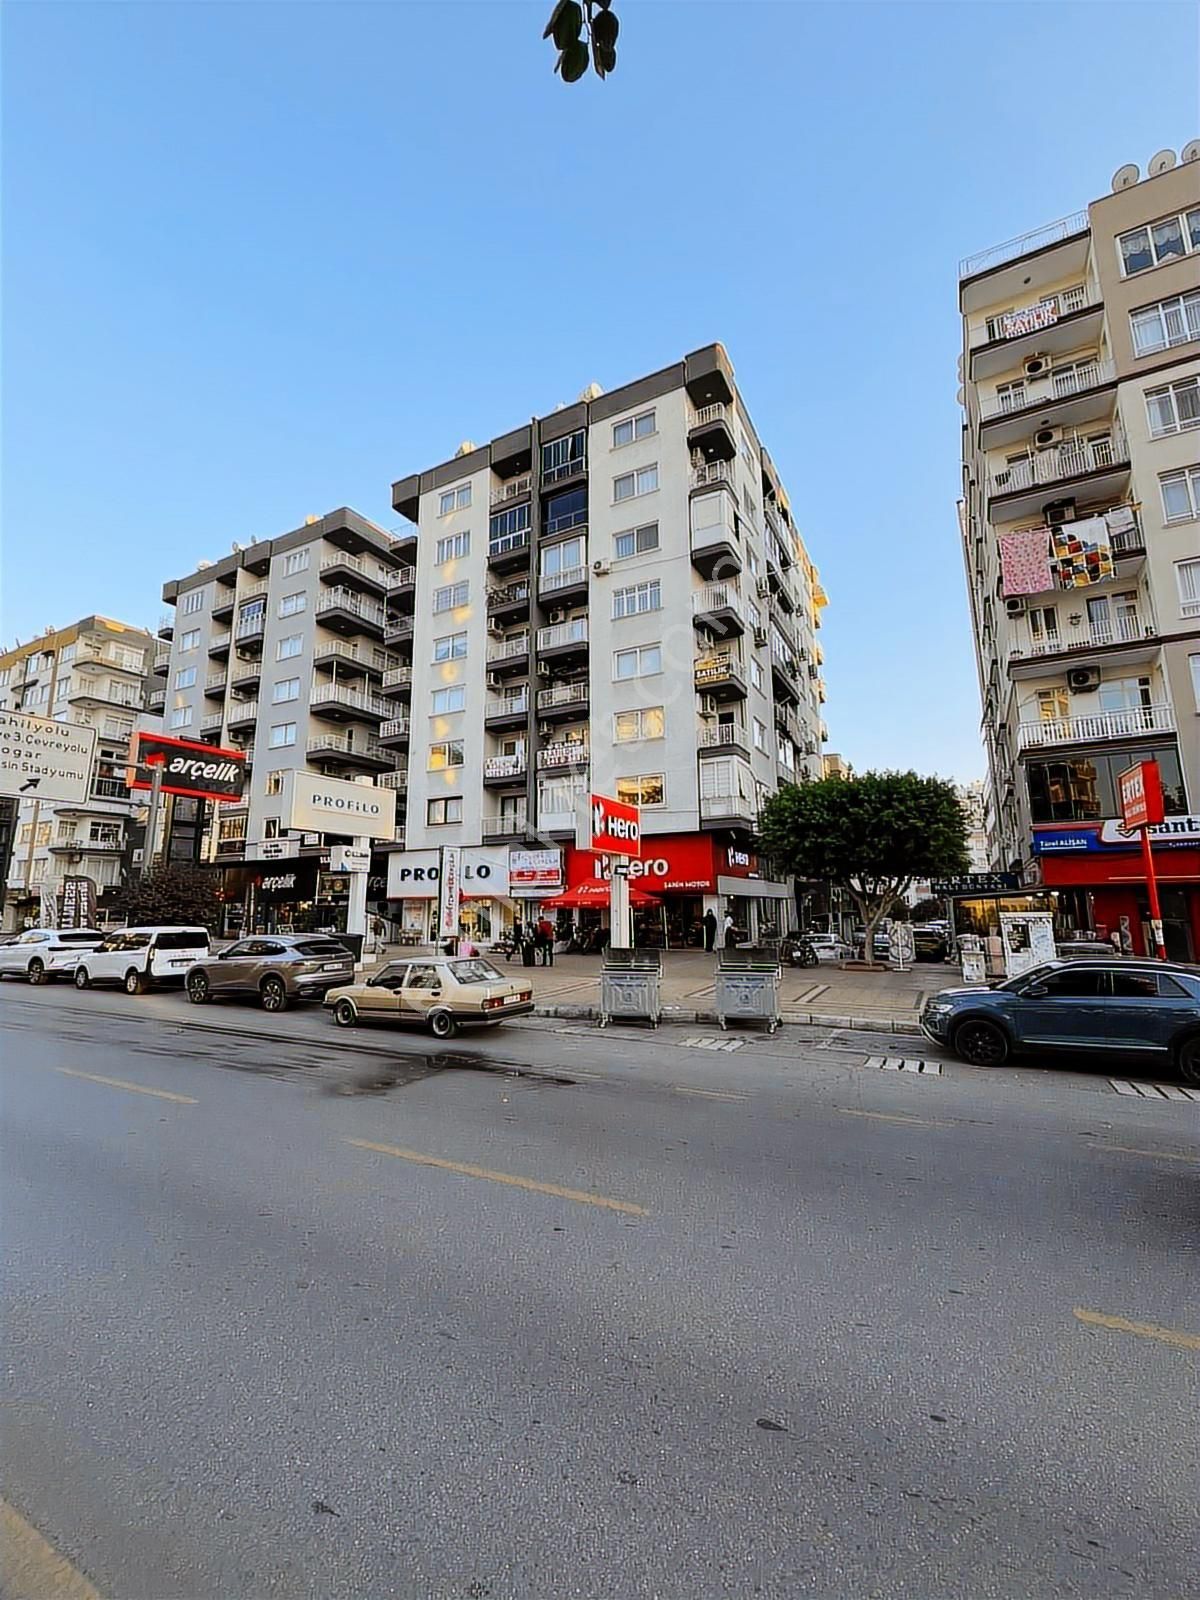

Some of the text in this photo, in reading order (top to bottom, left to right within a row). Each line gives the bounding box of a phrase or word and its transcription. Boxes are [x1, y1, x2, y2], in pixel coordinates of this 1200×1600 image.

[21, 762, 84, 780] Stadyumu
[169, 756, 240, 783] arçelik
[607, 814, 638, 841] Hero
[400, 864, 491, 882] PROLO
